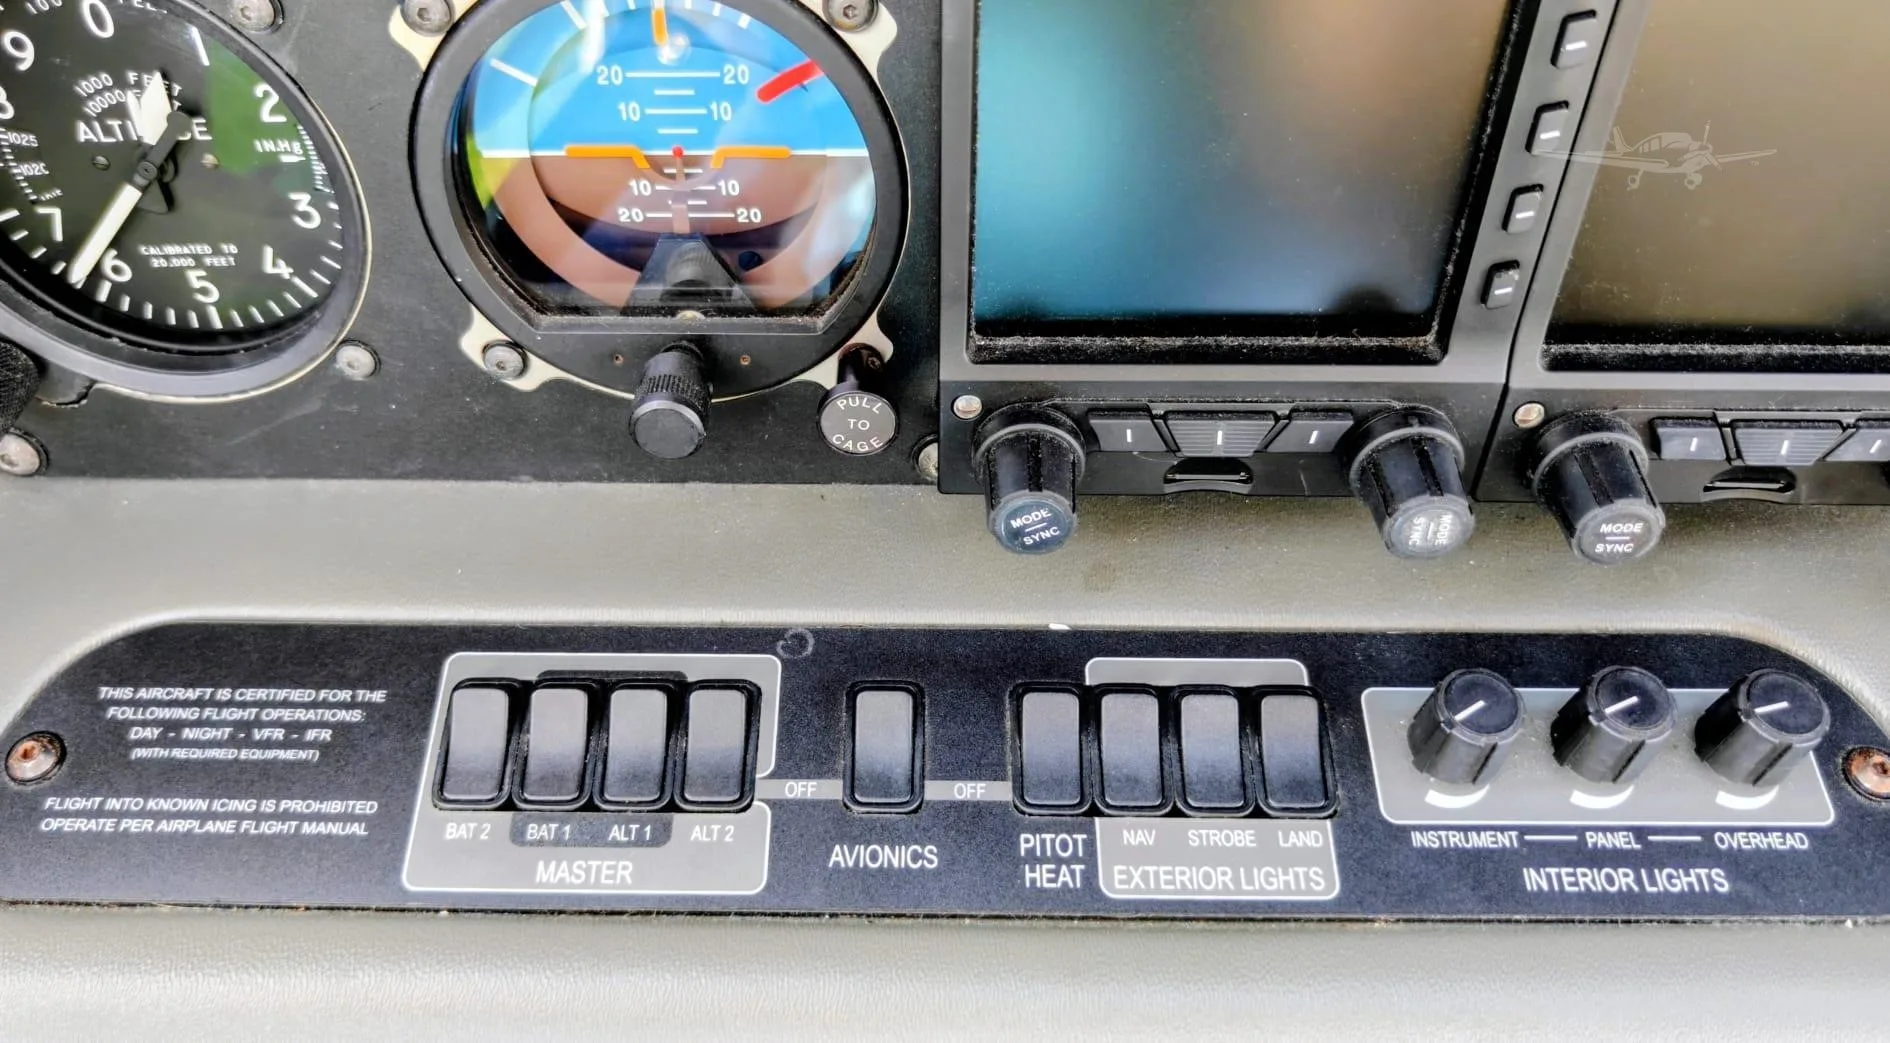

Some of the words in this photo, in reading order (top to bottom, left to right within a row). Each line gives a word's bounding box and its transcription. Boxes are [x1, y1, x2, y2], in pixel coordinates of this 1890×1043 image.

[82, 0, 114, 38] 0
[2, 30, 35, 71] 9
[190, 25, 210, 67] 1
[596, 66, 623, 84] 20
[724, 66, 750, 84] 20
[75, 72, 113, 97] 1000
[84, 89, 126, 117] 10000
[254, 82, 287, 122] 2
[619, 102, 640, 121] 10
[710, 102, 732, 121] 10
[8, 131, 38, 147] 1025
[78, 118, 212, 143] ALTIE
[630, 179, 651, 196] 10
[718, 179, 740, 196] 10
[288, 192, 321, 229] 3
[618, 207, 644, 223] 20
[737, 207, 762, 223] 20
[36, 206, 63, 242] 7
[139, 244, 213, 256] CALIBRATED
[220, 244, 239, 254] TO
[101, 250, 132, 282] 6
[204, 256, 236, 267] FEET
[262, 245, 294, 279] 4
[186, 269, 220, 303] 5
[836, 396, 882, 414] PULL
[848, 418, 870, 431] TO
[832, 434, 883, 452] CAGE
[1010, 507, 1052, 529] MODE
[1023, 526, 1060, 545] SYNC
[1408, 516, 1426, 546] SYNC
[1435, 513, 1453, 546] MODE
[1599, 522, 1644, 534] MODE
[1594, 543, 1634, 553] SYNC
[99, 687, 134, 700] THIS
[136, 687, 214, 701] AIRCRAFT
[216, 688, 232, 701] IS
[235, 688, 316, 702] CERTIFIED
[319, 689, 352, 702] FOR
[356, 690, 388, 703] THE
[106, 706, 200, 720] FOLLOWING
[203, 707, 259, 721] FLIGHT
[261, 708, 366, 722] OPERATIONS:
[129, 726, 163, 740] DAY
[181, 727, 234, 740] NIGHT
[253, 728, 285, 741] VFR
[304, 728, 333, 741] IFR
[131, 747, 169, 760] (WITH
[171, 748, 238, 760] REQUIRED
[240, 748, 320, 762] EQUIPMENT)
[784, 781, 818, 798] OFF
[953, 782, 987, 799] OFF
[44, 796, 104, 810] FLIGHT
[105, 797, 144, 811] INTO
[147, 798, 210, 811] KNOWN
[211, 798, 256, 812] ICING
[260, 799, 277, 813] IS
[279, 799, 379, 814] PROHIBITED
[40, 818, 117, 832] OPERATE
[119, 819, 154, 833] PER
[156, 819, 237, 833] AIRPLANE
[240, 821, 299, 834] FLIGHT
[301, 821, 369, 836] MANUAL
[445, 823, 477, 840] BAT
[479, 824, 490, 840] 2
[526, 823, 559, 841] BAT
[562, 824, 571, 841] 1
[608, 824, 639, 841] ALT
[642, 825, 652, 841] 1
[690, 824, 721, 841] ALT
[723, 825, 735, 841] 2
[1019, 833, 1088, 858] PITOT
[1122, 829, 1156, 846] NAV
[1187, 829, 1257, 847] STROBE
[1278, 830, 1323, 847] LAND
[1410, 830, 1519, 849] INSTRUMENT
[1585, 831, 1642, 850] PANEL
[1714, 831, 1809, 850] OVERHEAD
[828, 844, 939, 869] AVIONICS
[535, 860, 634, 885] MASTER
[1024, 863, 1086, 889] HEAT
[1113, 865, 1235, 890] EXTERIOR
[1240, 867, 1326, 891] LIGHTS
[1522, 867, 1638, 891] INTERIOR
[1641, 868, 1730, 893] LIGHTS
